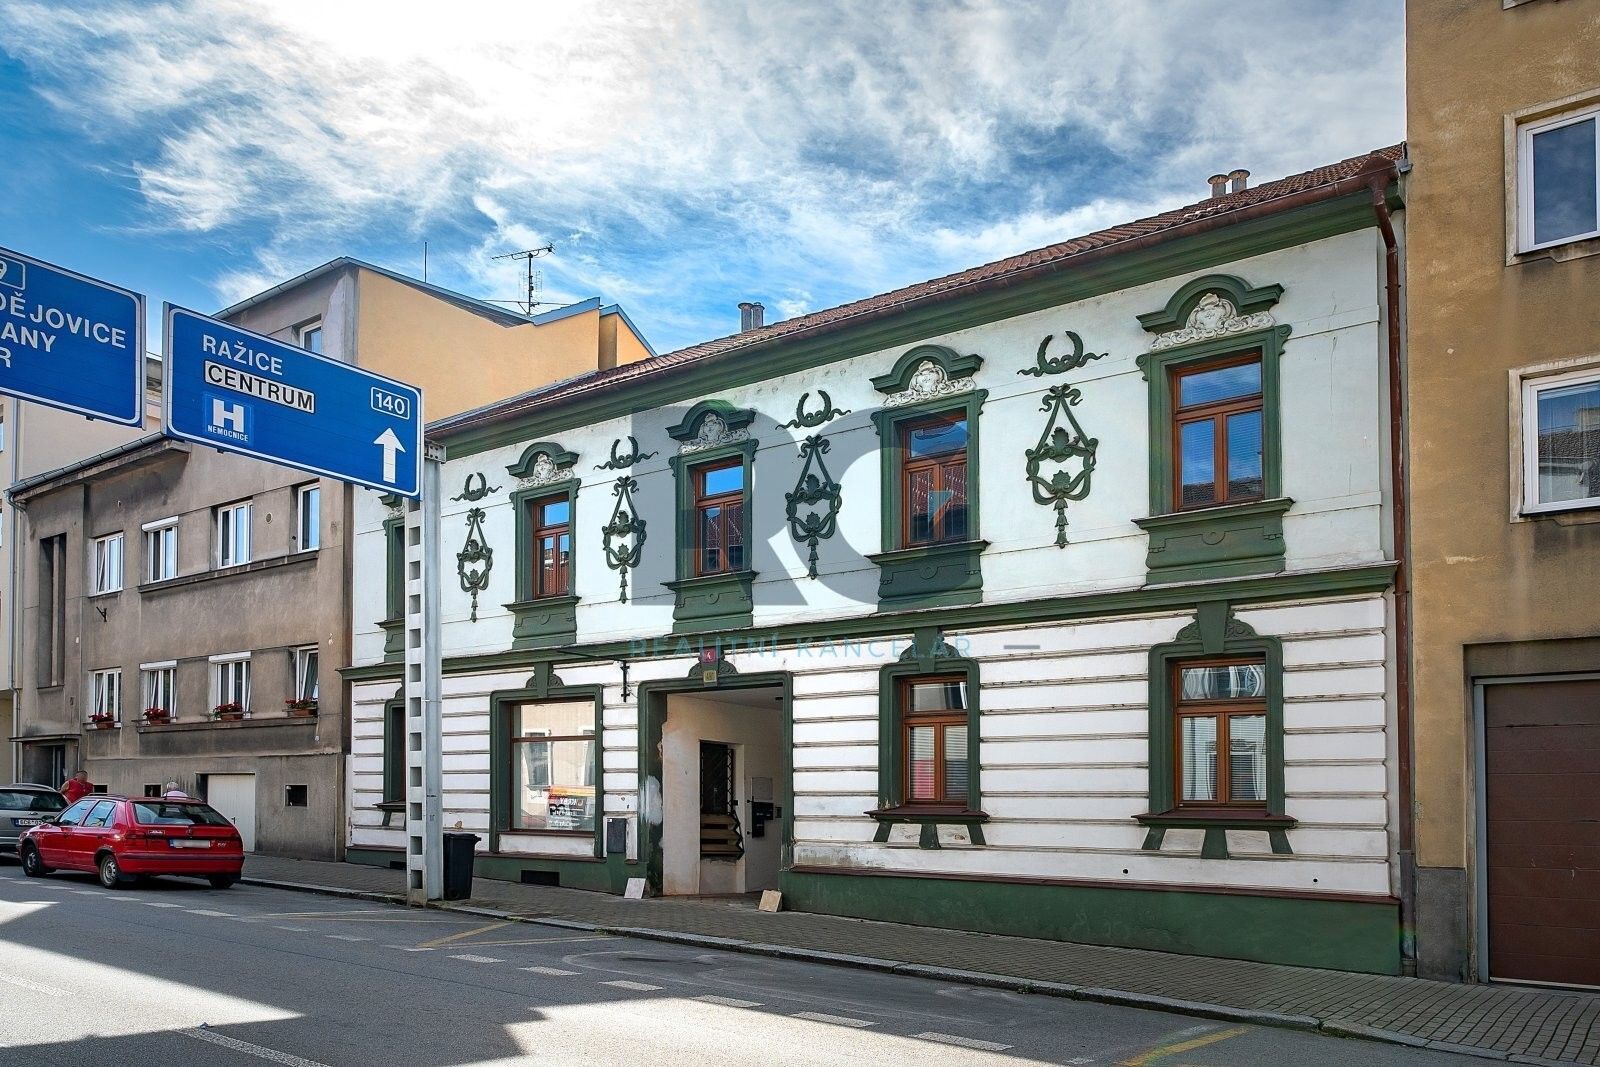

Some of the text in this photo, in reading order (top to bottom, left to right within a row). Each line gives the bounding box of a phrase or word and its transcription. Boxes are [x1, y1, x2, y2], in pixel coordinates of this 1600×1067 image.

[203, 334, 283, 376] RAŽICE
[208, 364, 314, 411] CENTRUM
[376, 392, 405, 415] 140
[207, 424, 249, 442] NEMOCNICE
[213, 398, 245, 433] H
